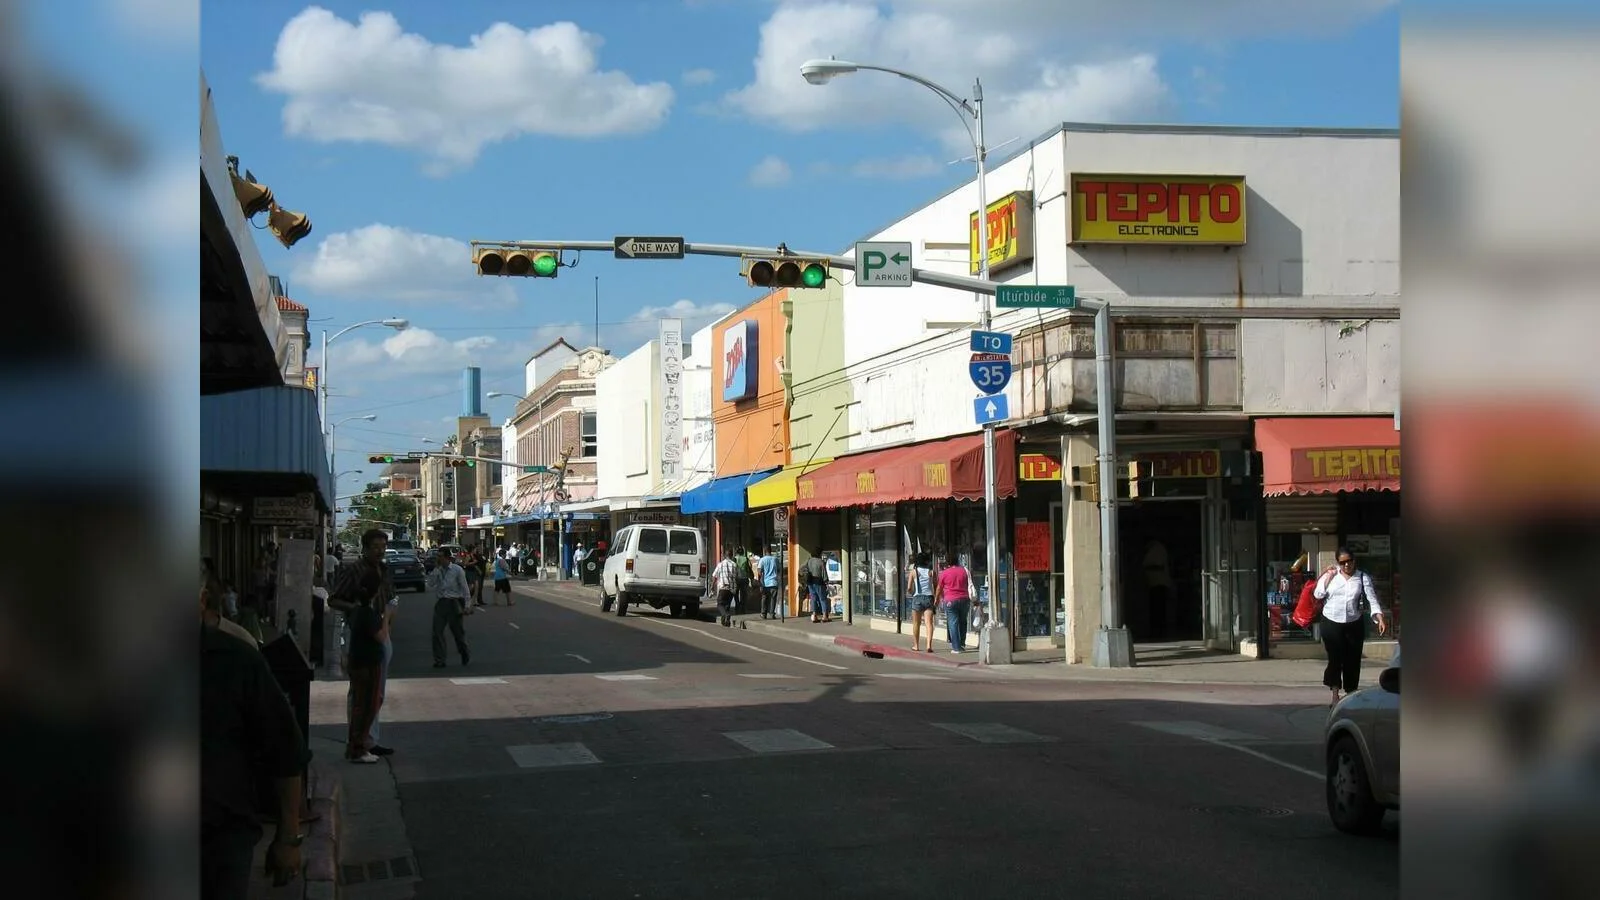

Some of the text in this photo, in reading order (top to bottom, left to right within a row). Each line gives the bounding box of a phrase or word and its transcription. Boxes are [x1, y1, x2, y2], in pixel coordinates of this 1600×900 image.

[1080, 181, 1241, 224] TEPITO
[1118, 225, 1199, 236] ELECTRONICS
[631, 243, 675, 252] ONE WAY
[1002, 290, 1047, 303] Iturbide
[981, 335, 1002, 349] TO
[977, 365, 1005, 386] 35
[1142, 451, 1217, 476] EPITO
